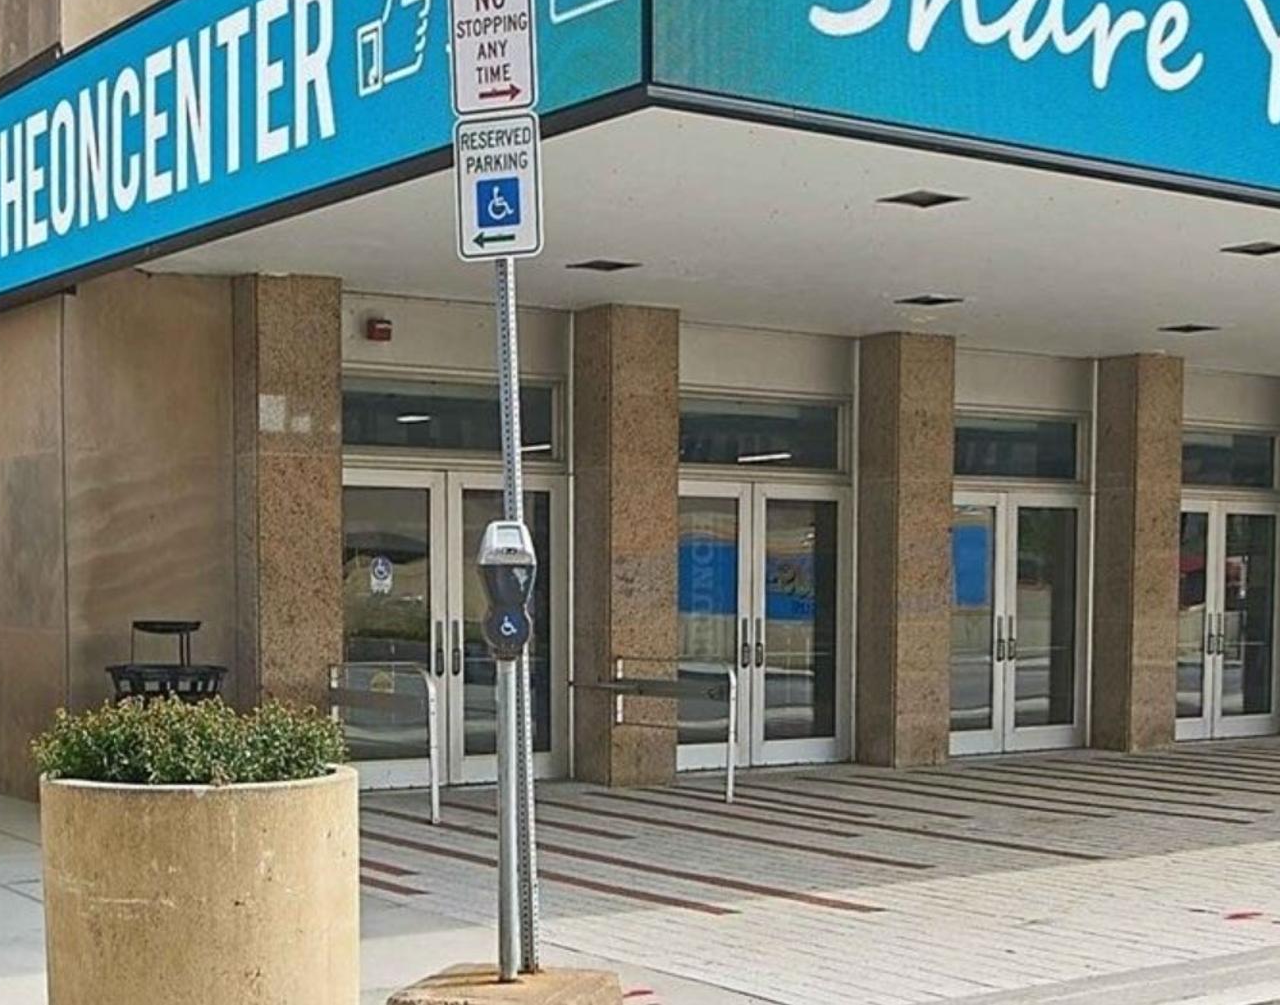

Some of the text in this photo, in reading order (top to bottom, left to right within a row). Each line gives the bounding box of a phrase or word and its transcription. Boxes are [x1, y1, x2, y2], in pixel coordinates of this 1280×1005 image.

[456, 12, 528, 39] STOPPING
[477, 39, 508, 60] ANY
[476, 62, 512, 84] TIME
[460, 126, 532, 152] RESERVED
[466, 151, 528, 174] PARKING
